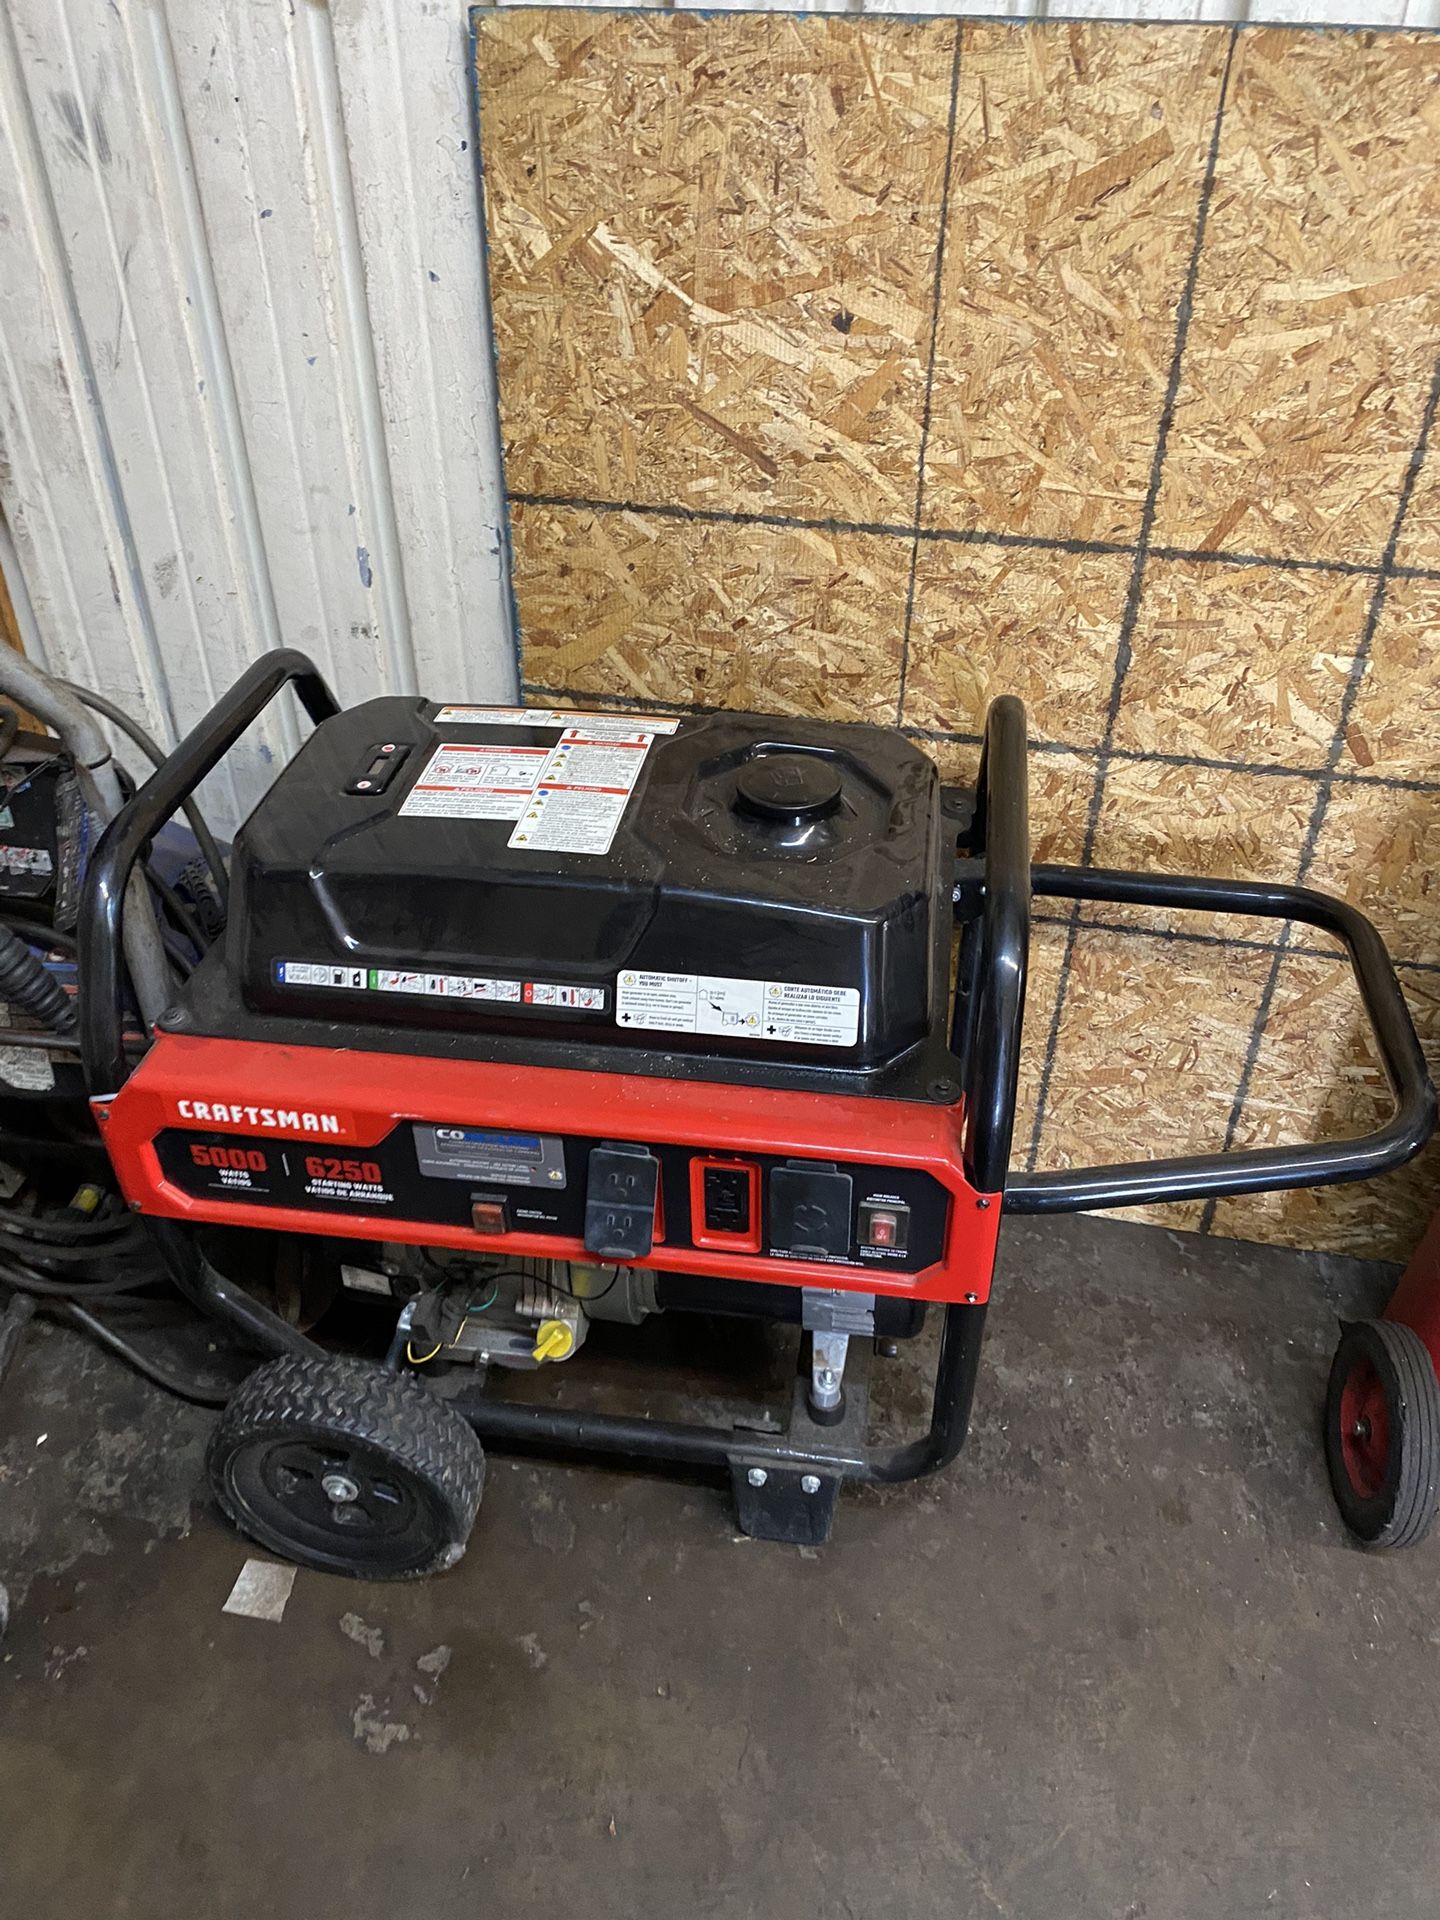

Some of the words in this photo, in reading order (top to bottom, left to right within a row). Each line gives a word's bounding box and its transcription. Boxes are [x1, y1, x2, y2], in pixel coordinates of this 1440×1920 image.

[639, 974, 666, 982] AUTOMATIC
[784, 992, 808, 1000] REALIZAR
[177, 1099, 339, 1134] CRAFTSMAN
[436, 1128, 465, 1141] CO
[190, 1144, 267, 1172] 5000
[218, 1168, 250, 1179] WATTS
[305, 1156, 382, 1184] 6250
[220, 1177, 252, 1187] VATIOS
[311, 1178, 352, 1190] STARTING
[353, 1182, 384, 1192] WATTS
[304, 1186, 336, 1196] VATIOS
[336, 1189, 348, 1197] DE
[349, 1190, 394, 1202] ARRANQUE
